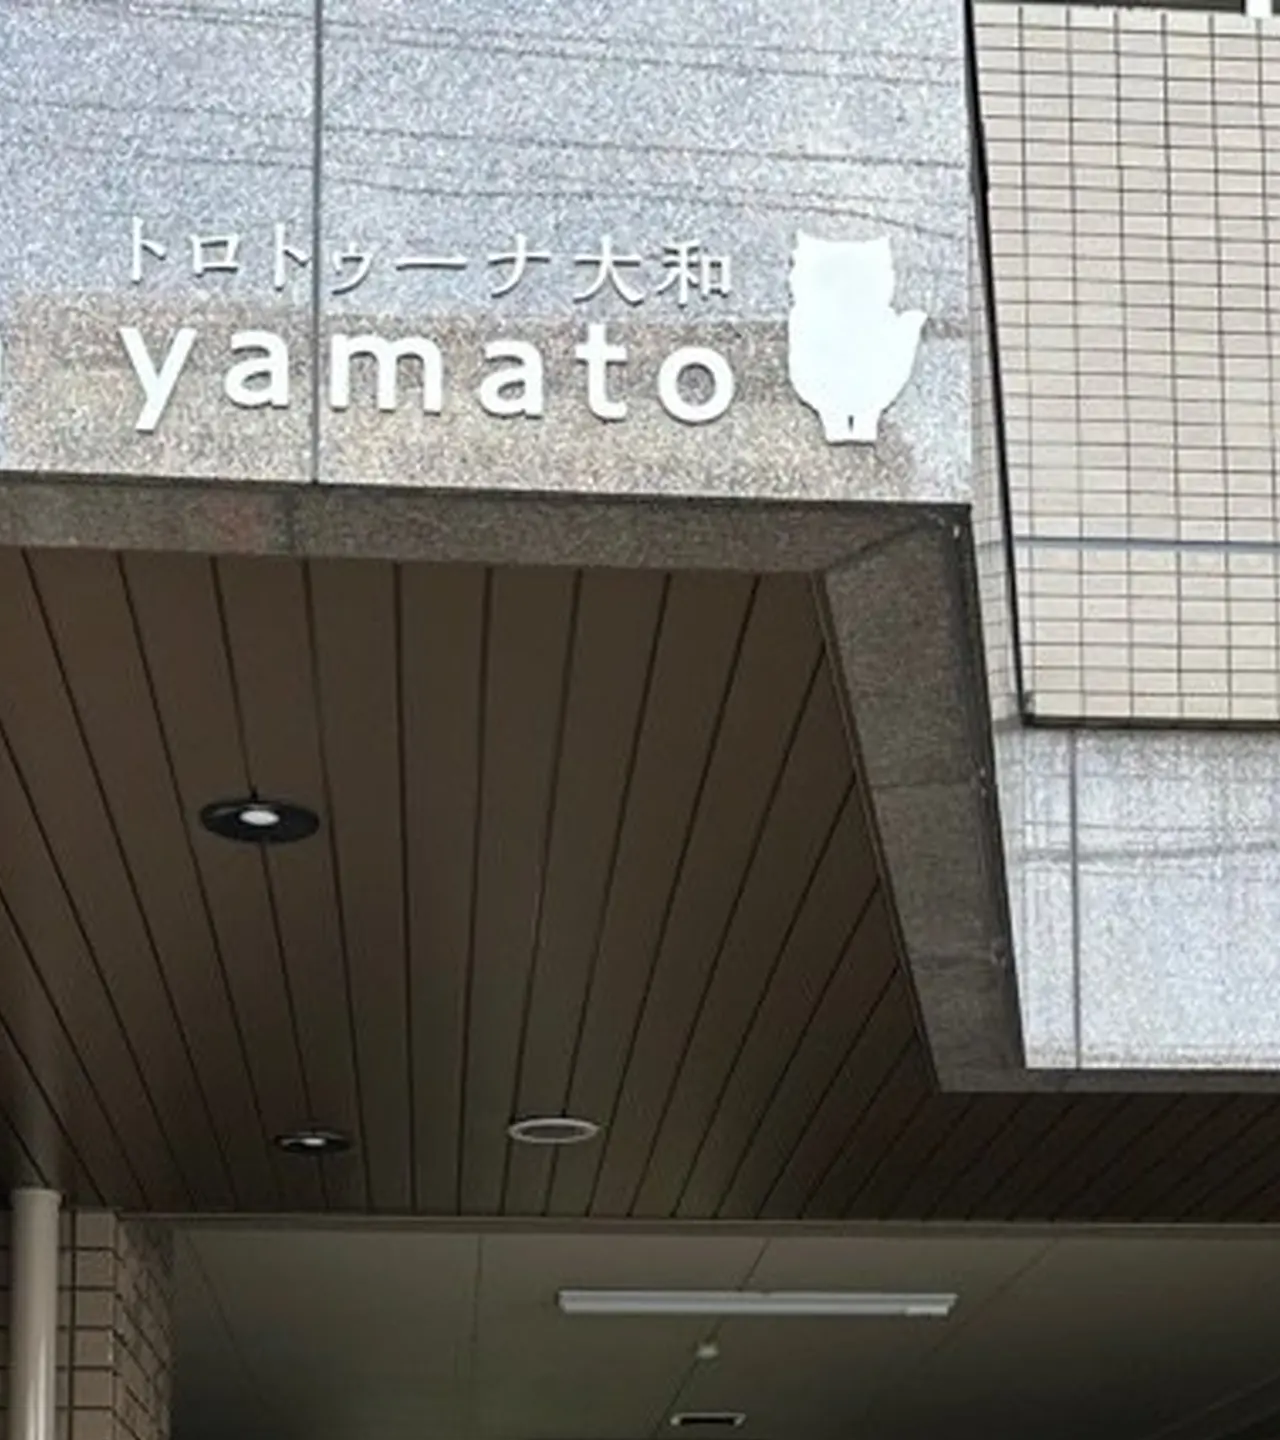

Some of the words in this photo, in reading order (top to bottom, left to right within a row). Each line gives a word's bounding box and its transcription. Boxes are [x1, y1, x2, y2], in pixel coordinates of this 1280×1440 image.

[129, 218, 731, 306] トロトゥーナ大和
[119, 323, 735, 432] yamato
